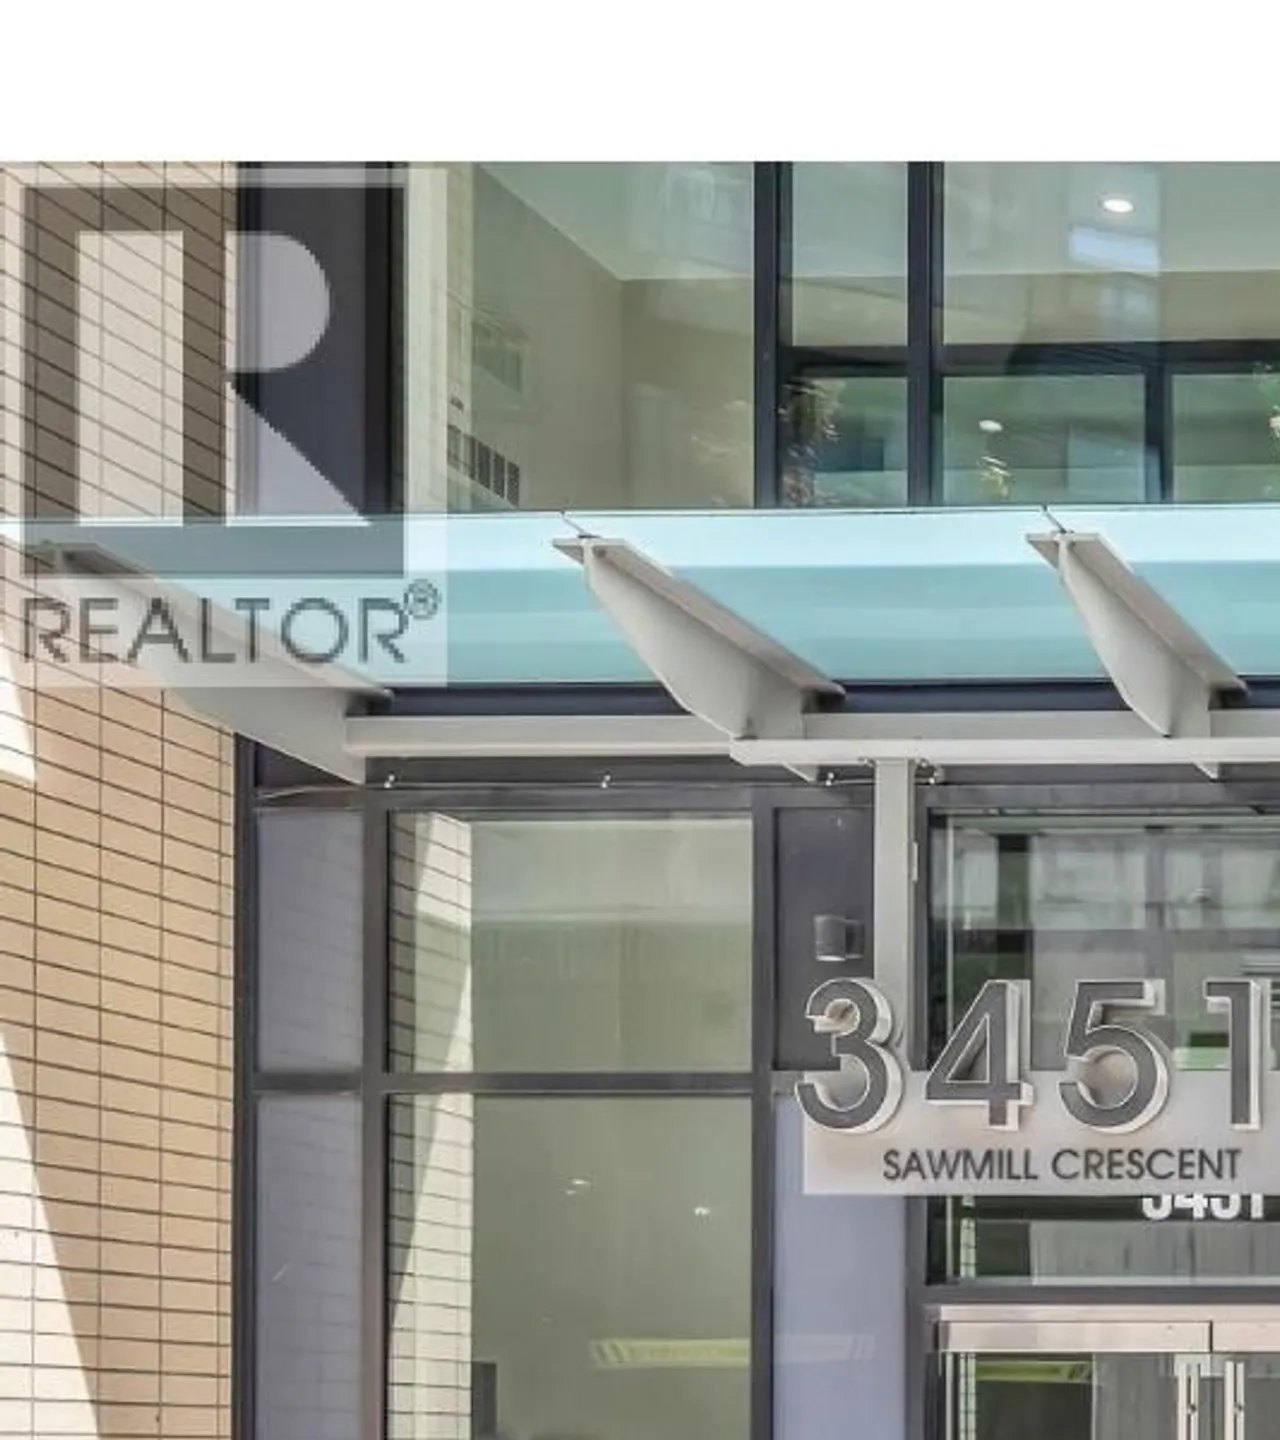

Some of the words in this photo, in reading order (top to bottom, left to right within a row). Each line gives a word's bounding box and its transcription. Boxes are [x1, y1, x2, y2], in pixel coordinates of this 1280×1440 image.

[797, 978, 1263, 1134] 3451
[882, 1148, 1038, 1180] SAWMILL
[1051, 1148, 1242, 1180] CRESCENT
